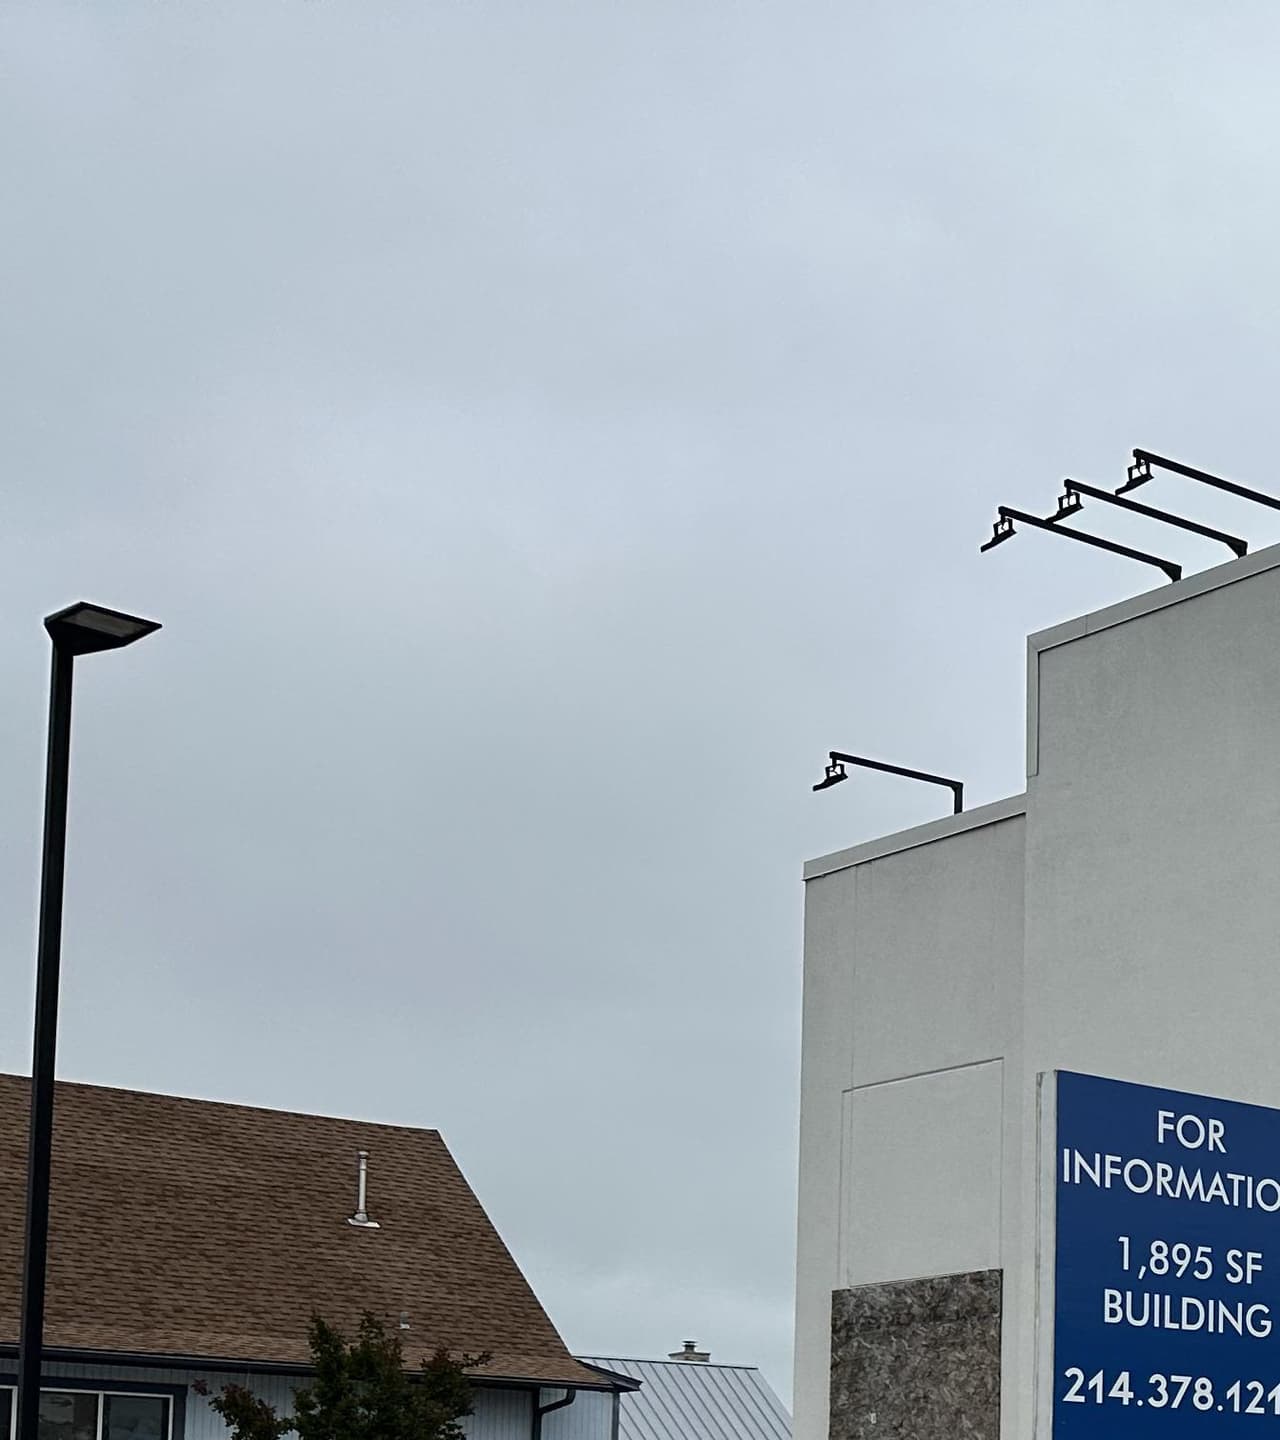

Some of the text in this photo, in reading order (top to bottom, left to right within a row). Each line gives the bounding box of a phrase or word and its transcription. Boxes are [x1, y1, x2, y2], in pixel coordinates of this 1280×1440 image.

[1157, 1109, 1227, 1153] FOR
[1118, 1236, 1263, 1284] 1,895 SF
[1103, 1288, 1273, 1338] BUILDING
